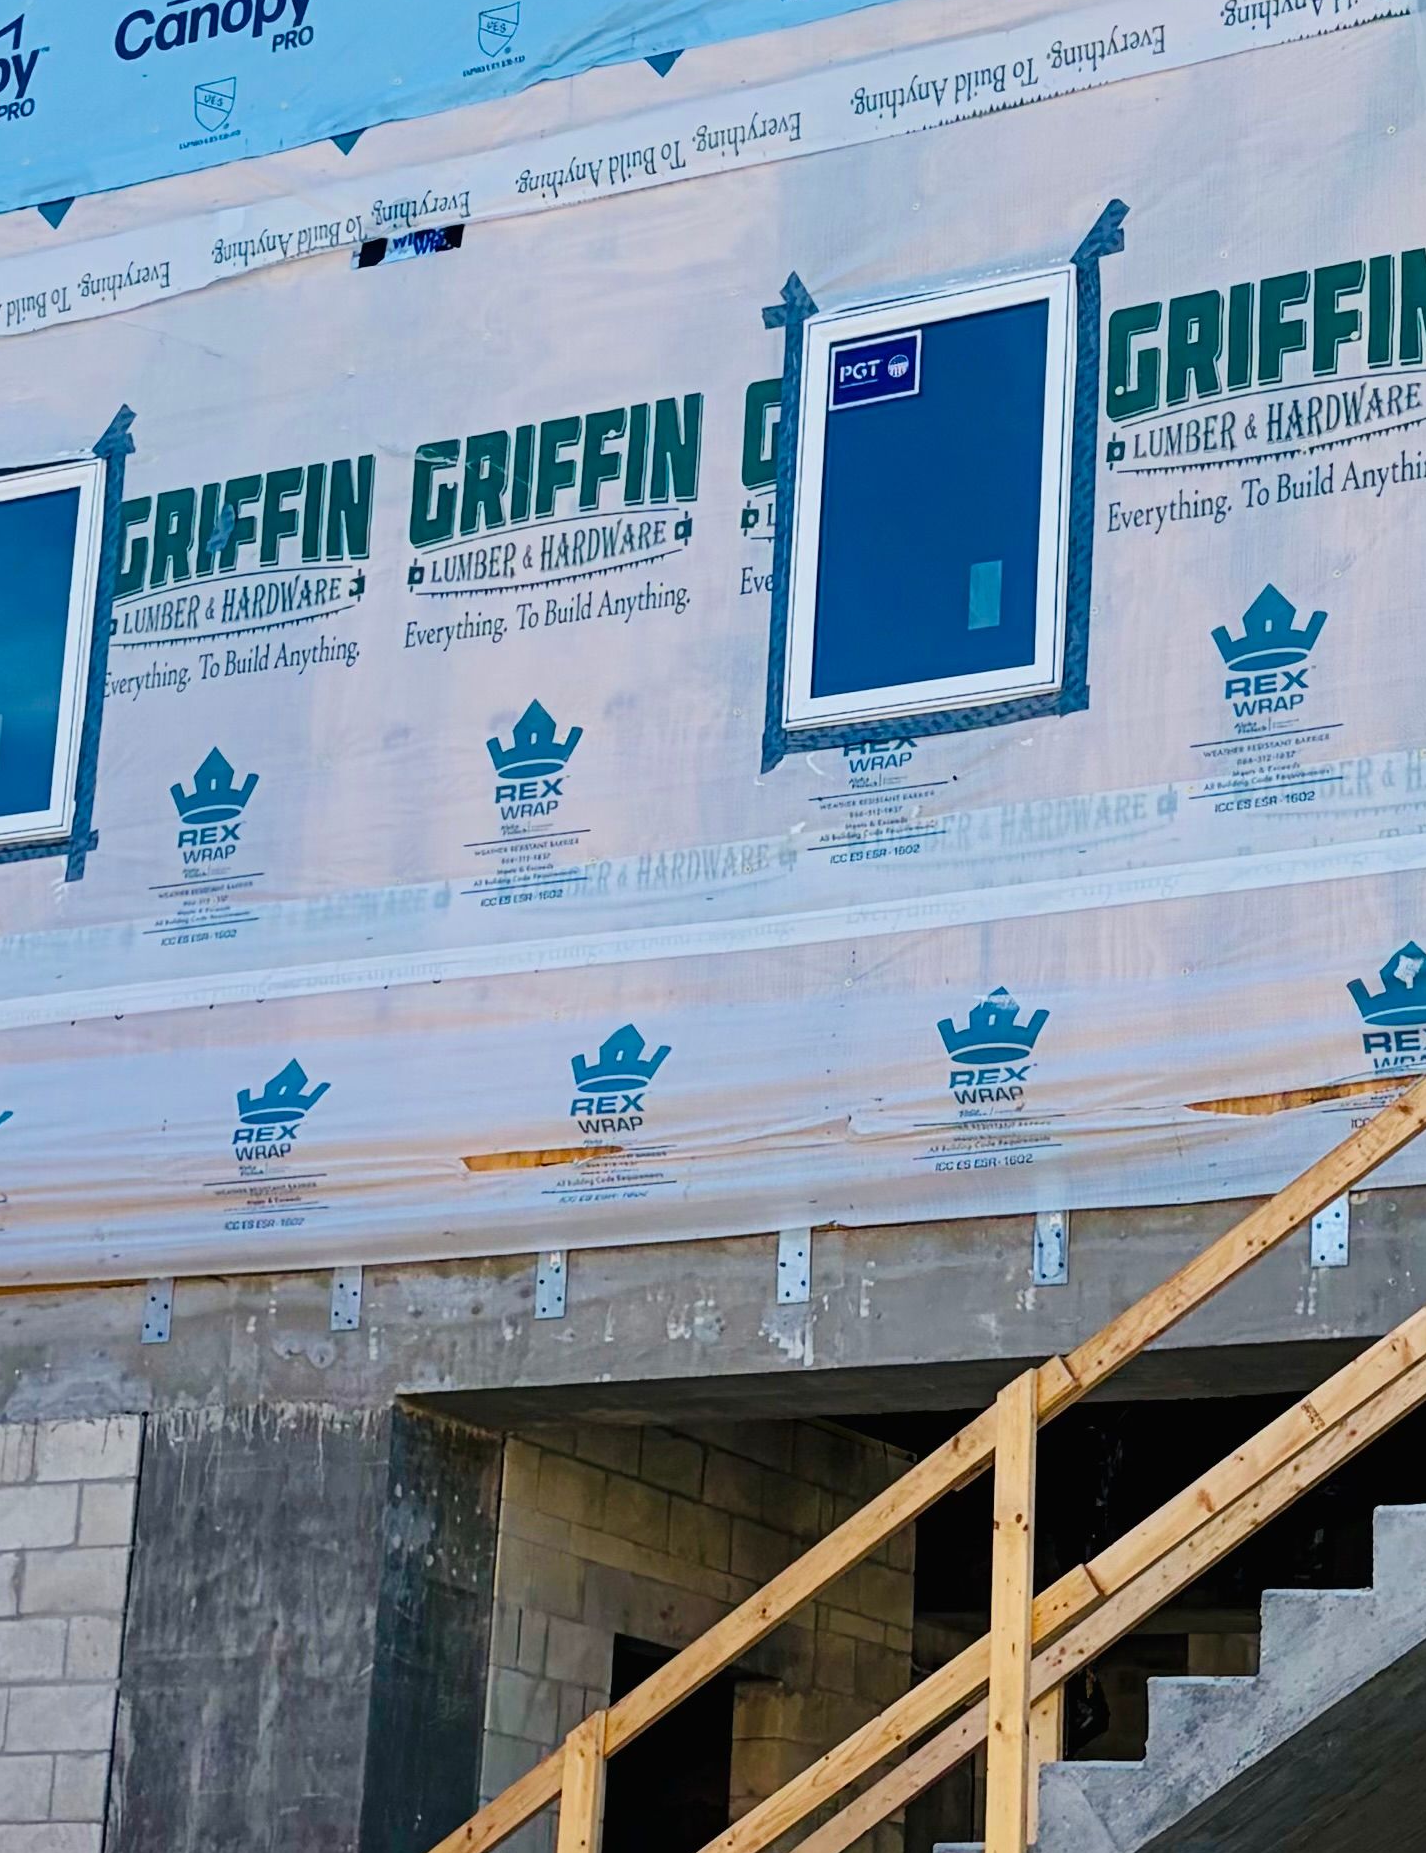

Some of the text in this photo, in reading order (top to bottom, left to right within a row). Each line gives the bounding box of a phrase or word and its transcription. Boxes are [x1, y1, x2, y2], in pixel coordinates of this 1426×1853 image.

[273, 26, 314, 53] PRO
[850, 24, 1167, 117] Everything. Build Anything.
[516, 111, 803, 198] Everything. Anything.
[839, 359, 878, 383] PGT
[1133, 382, 1423, 461] LUMBER HARDWARE
[408, 392, 704, 551] GRIFFIN
[1107, 491, 1233, 533] Everything.
[1242, 478, 1270, 510] To
[1277, 465, 1334, 504] Build
[115, 454, 376, 598] GRIFFIN
[540, 517, 666, 574] HARDWARE
[123, 573, 342, 635] LUMBER HARDWARE
[405, 582, 691, 650] Everything. Build Anything.
[224, 634, 361, 676] Build Anything.
[1224, 668, 1310, 701] REX
[1232, 691, 1305, 719] WRAP
[850, 751, 912, 773] WRAP
[494, 777, 564, 805] REX
[500, 798, 559, 821] WRAP
[1215, 801, 1234, 813] ICC
[177, 823, 241, 848] REX
[182, 844, 236, 865] WRAP
[949, 1064, 1031, 1088] REX
[570, 1094, 644, 1117] REX
[954, 1084, 1024, 1106] WRAP
[232, 1124, 299, 1146] REX
[578, 1114, 644, 1134] WRAP
[235, 1142, 292, 1161] WRAP
